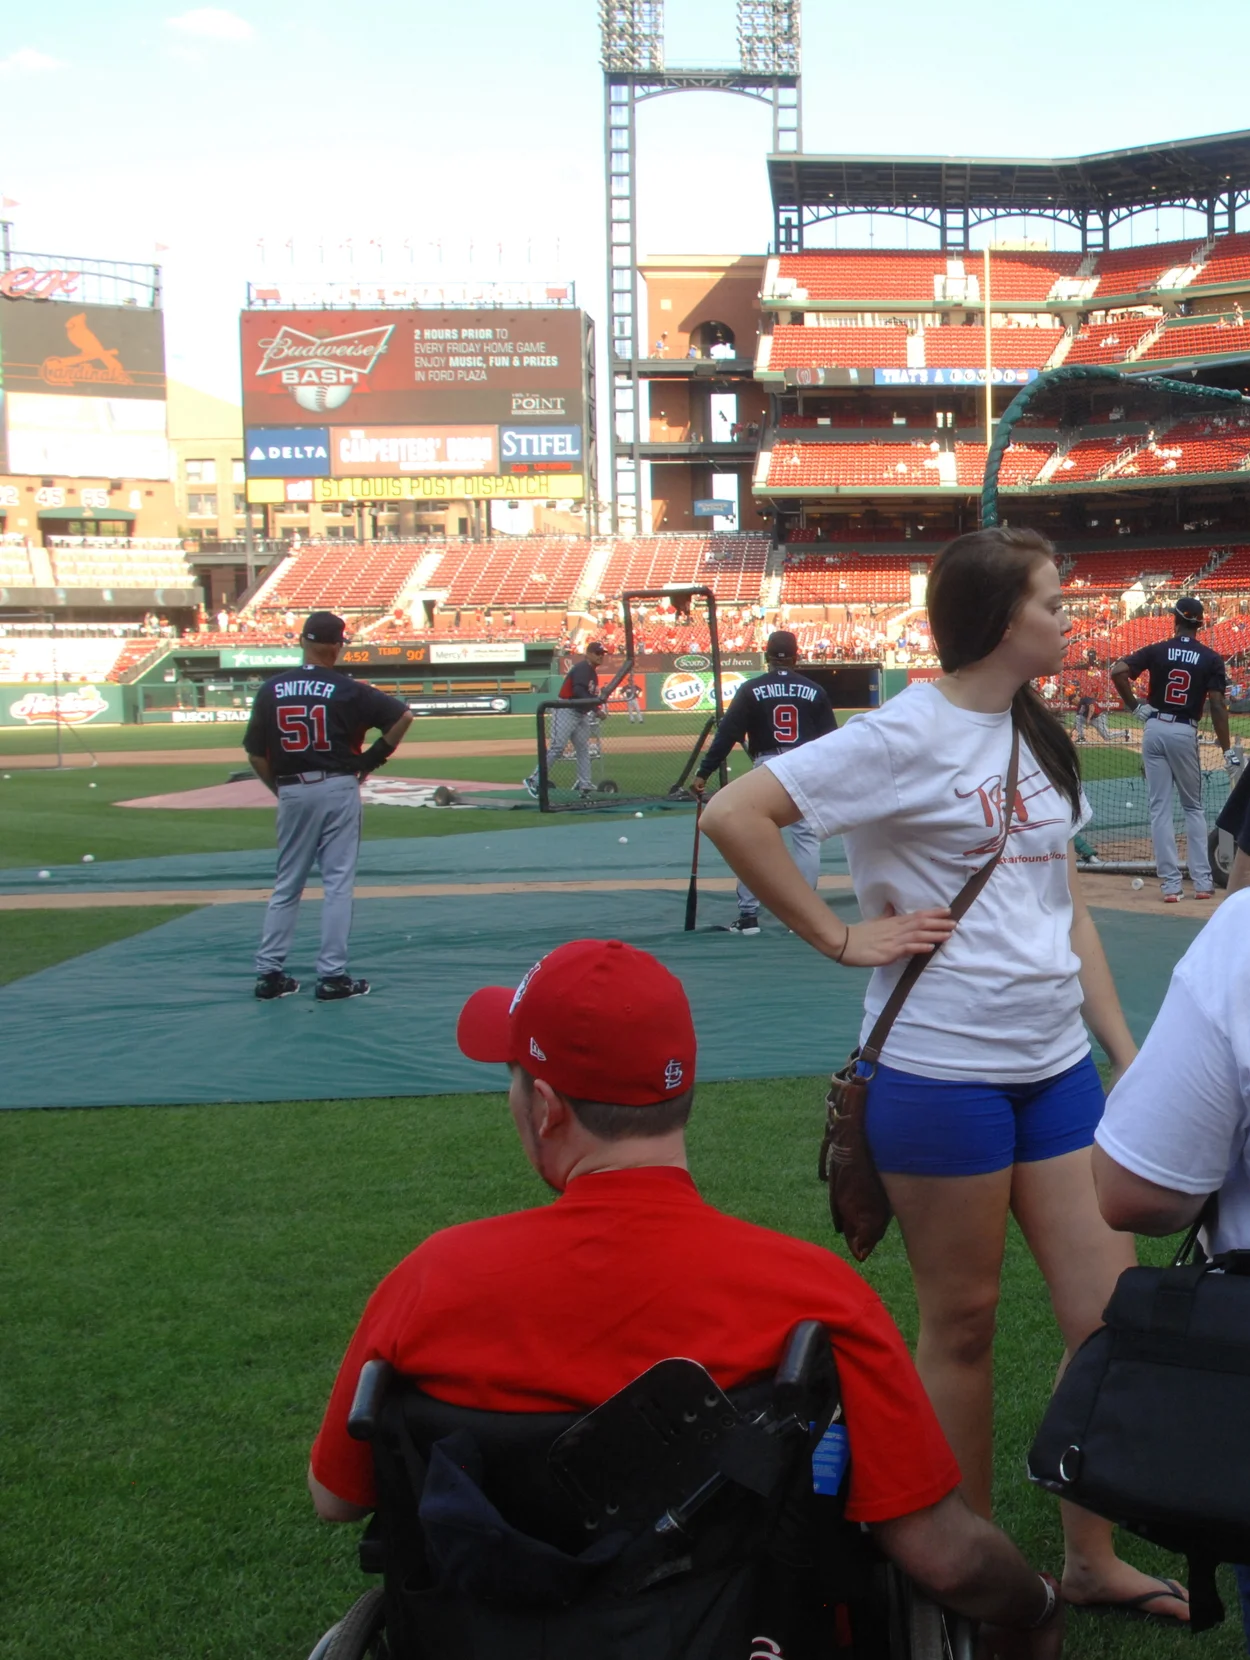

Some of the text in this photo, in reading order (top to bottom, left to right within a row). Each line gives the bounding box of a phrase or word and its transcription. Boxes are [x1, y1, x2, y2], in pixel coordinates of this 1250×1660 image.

[413, 329, 509, 340] 2 HOURS PRIOR TO
[257, 338, 388, 360] Budweiser
[414, 342, 546, 354] EVERY FRIDAY HOME GAME
[414, 356, 559, 369] ENJOY MUSIC, FUN & PRIZES
[281, 369, 359, 384] BASH
[414, 370, 488, 382] IN FORD PLAZA
[512, 398, 566, 409] POINT
[502, 431, 580, 456] STIFEL
[268, 446, 328, 459] DELTA
[351, 478, 402, 496] LOUIS
[377, 647, 402, 656] TEMP
[435, 651, 462, 660] Mercy
[1168, 648, 1200, 665] UPTON
[275, 680, 335, 699] SNITKER
[664, 684, 702, 702] Gulf
[752, 683, 818, 702] PENDLETON
[1164, 668, 1192, 706] 2
[172, 711, 214, 723] BUSCH
[772, 704, 799, 743] 9
[276, 704, 332, 753] 51
